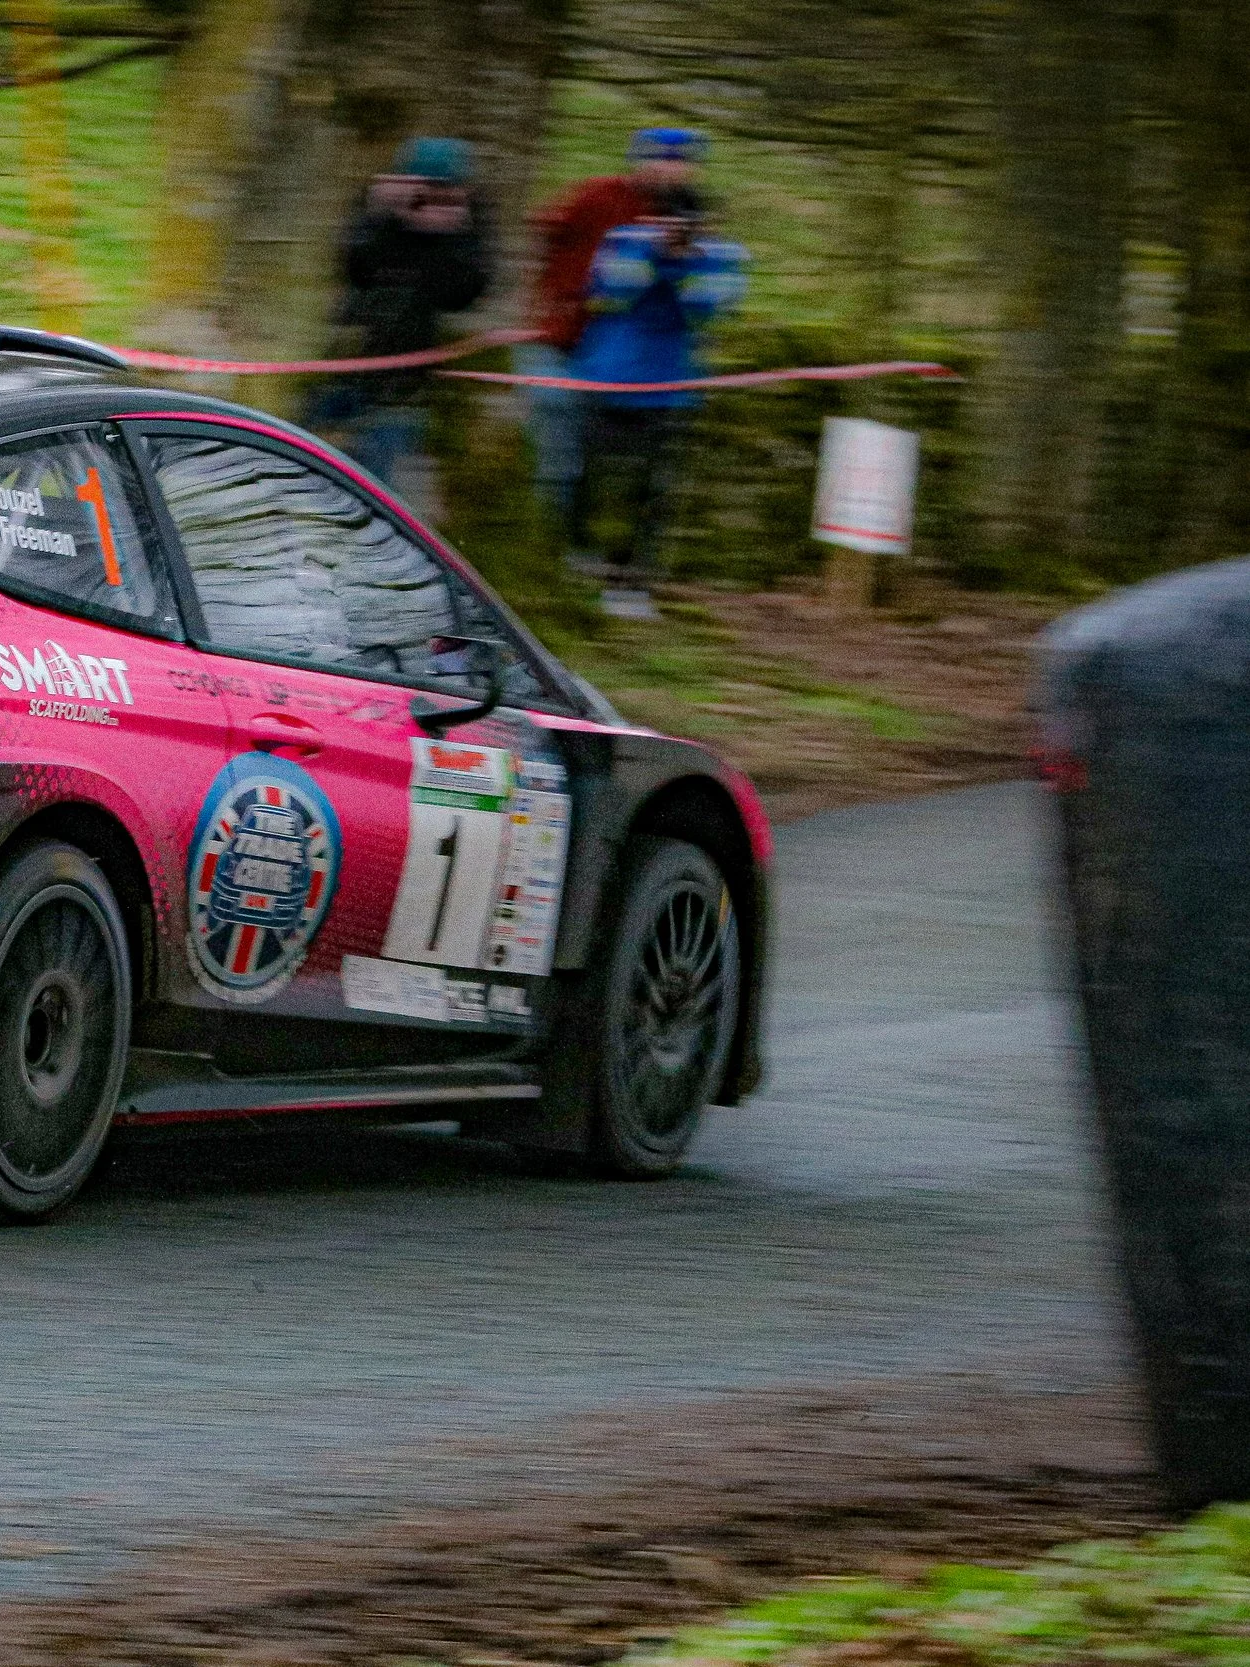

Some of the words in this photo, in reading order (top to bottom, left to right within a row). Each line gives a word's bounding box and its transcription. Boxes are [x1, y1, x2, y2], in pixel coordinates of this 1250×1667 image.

[0, 514, 77, 557] Freeman
[76, 467, 122, 587] 1
[28, 698, 111, 725] SCAFFOLDING
[427, 815, 462, 952] 1
